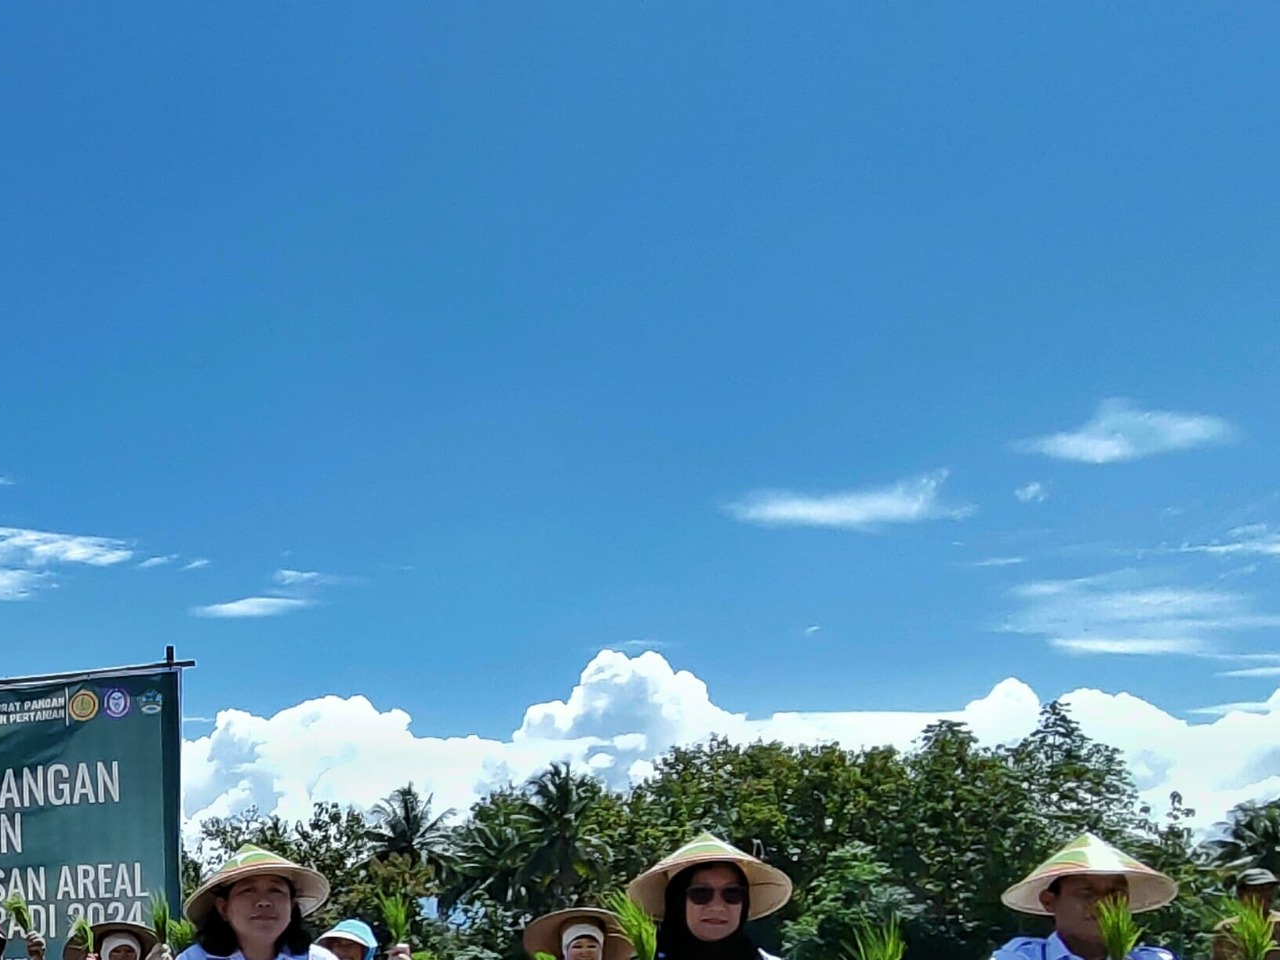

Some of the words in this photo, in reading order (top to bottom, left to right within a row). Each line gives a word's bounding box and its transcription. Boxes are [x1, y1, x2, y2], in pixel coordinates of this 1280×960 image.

[23, 697, 65, 712] PANGAN
[9, 708, 65, 725] PERTANIAN
[56, 862, 150, 901] AREAL
